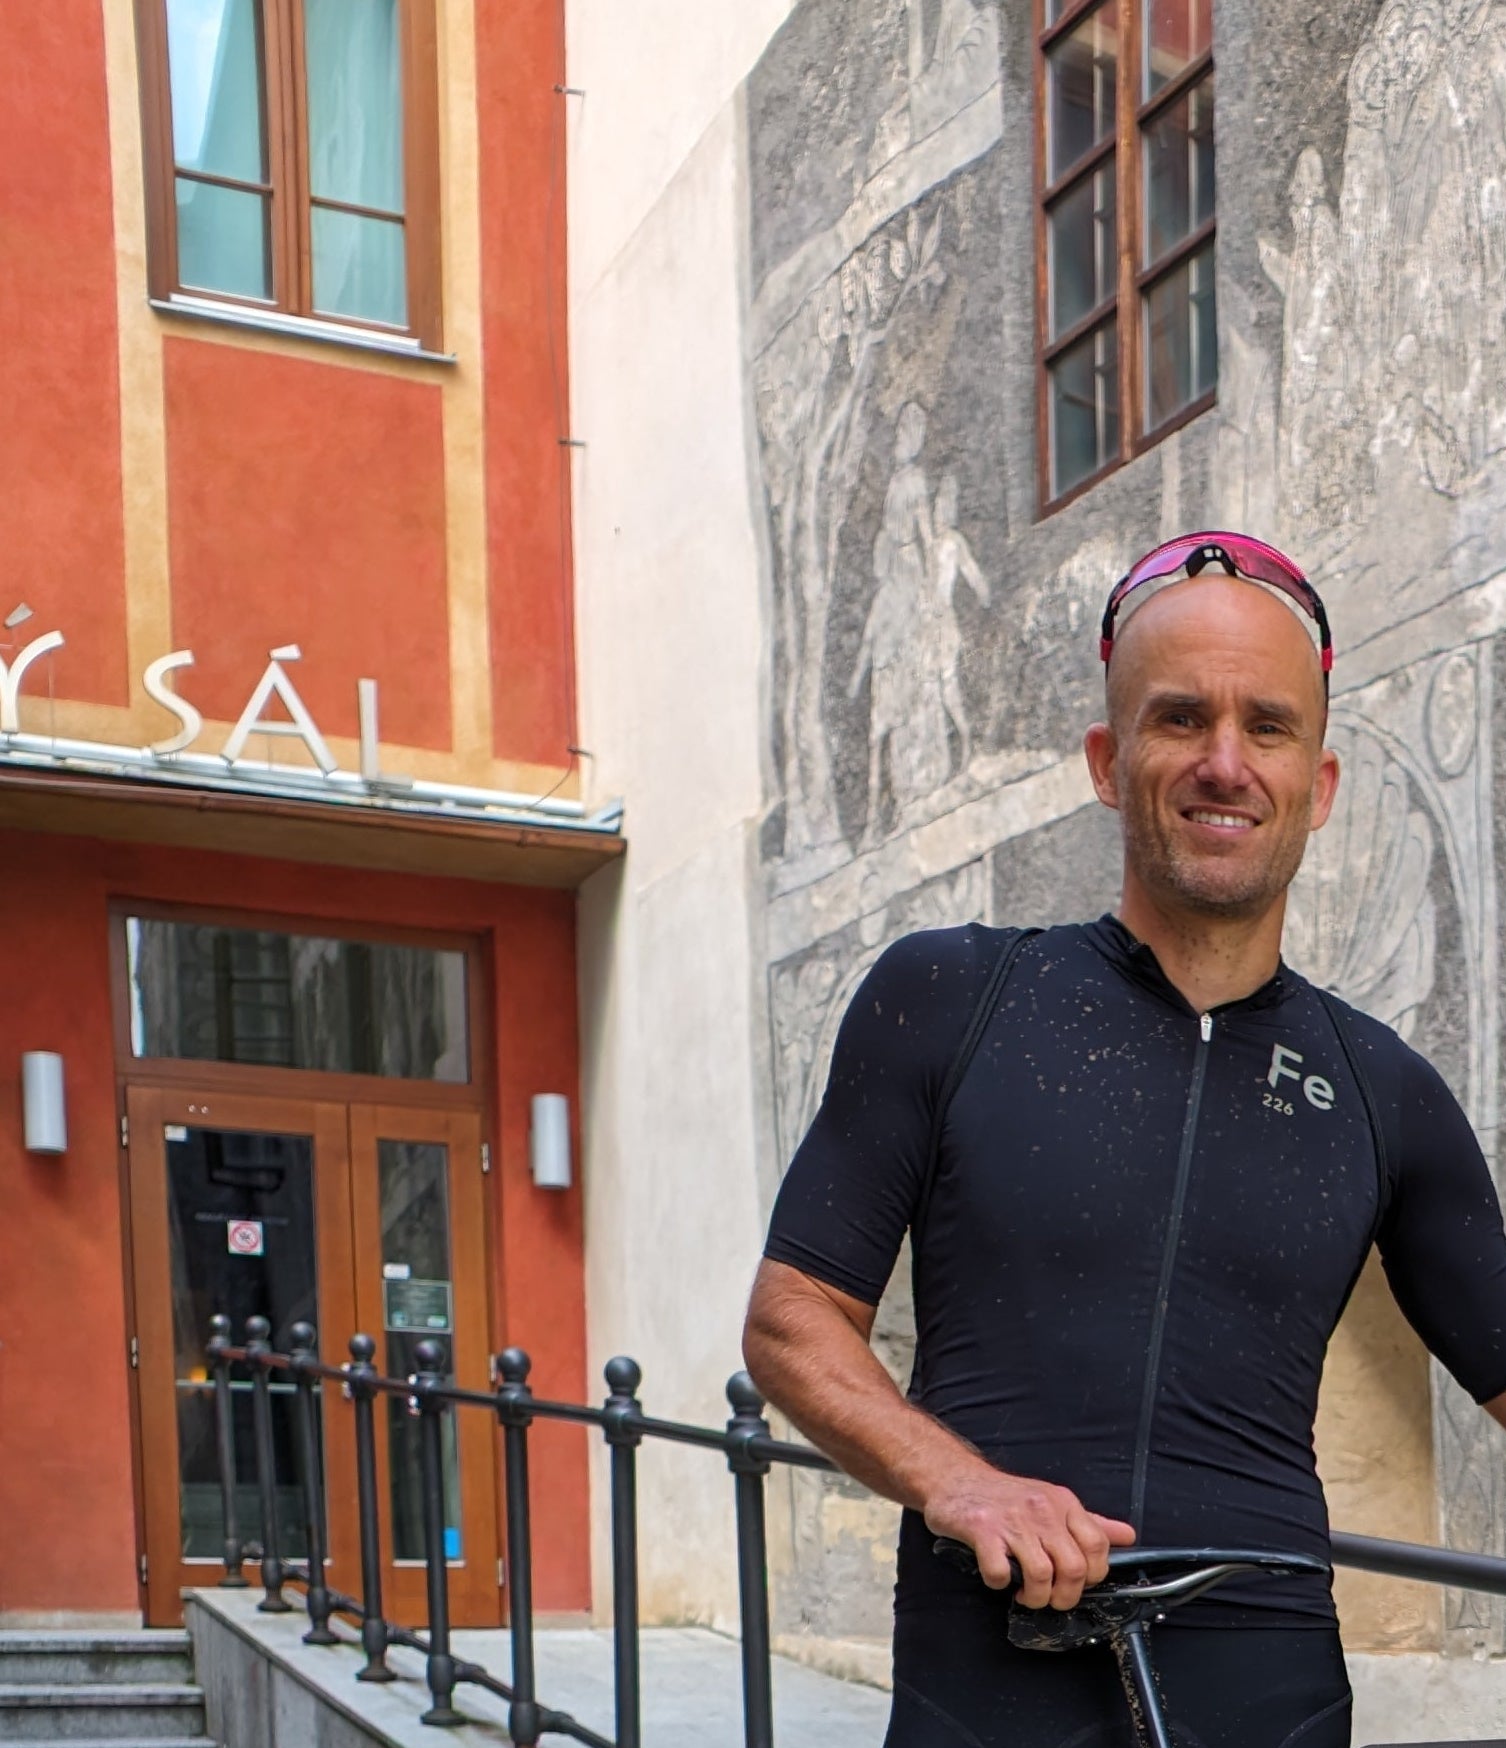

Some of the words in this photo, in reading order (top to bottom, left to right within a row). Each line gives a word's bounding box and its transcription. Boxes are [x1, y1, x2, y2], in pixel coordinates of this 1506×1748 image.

[142, 643, 413, 791] SÁL
[1262, 1093, 1295, 1116] 226
[1267, 1043, 1335, 1111] Fe
